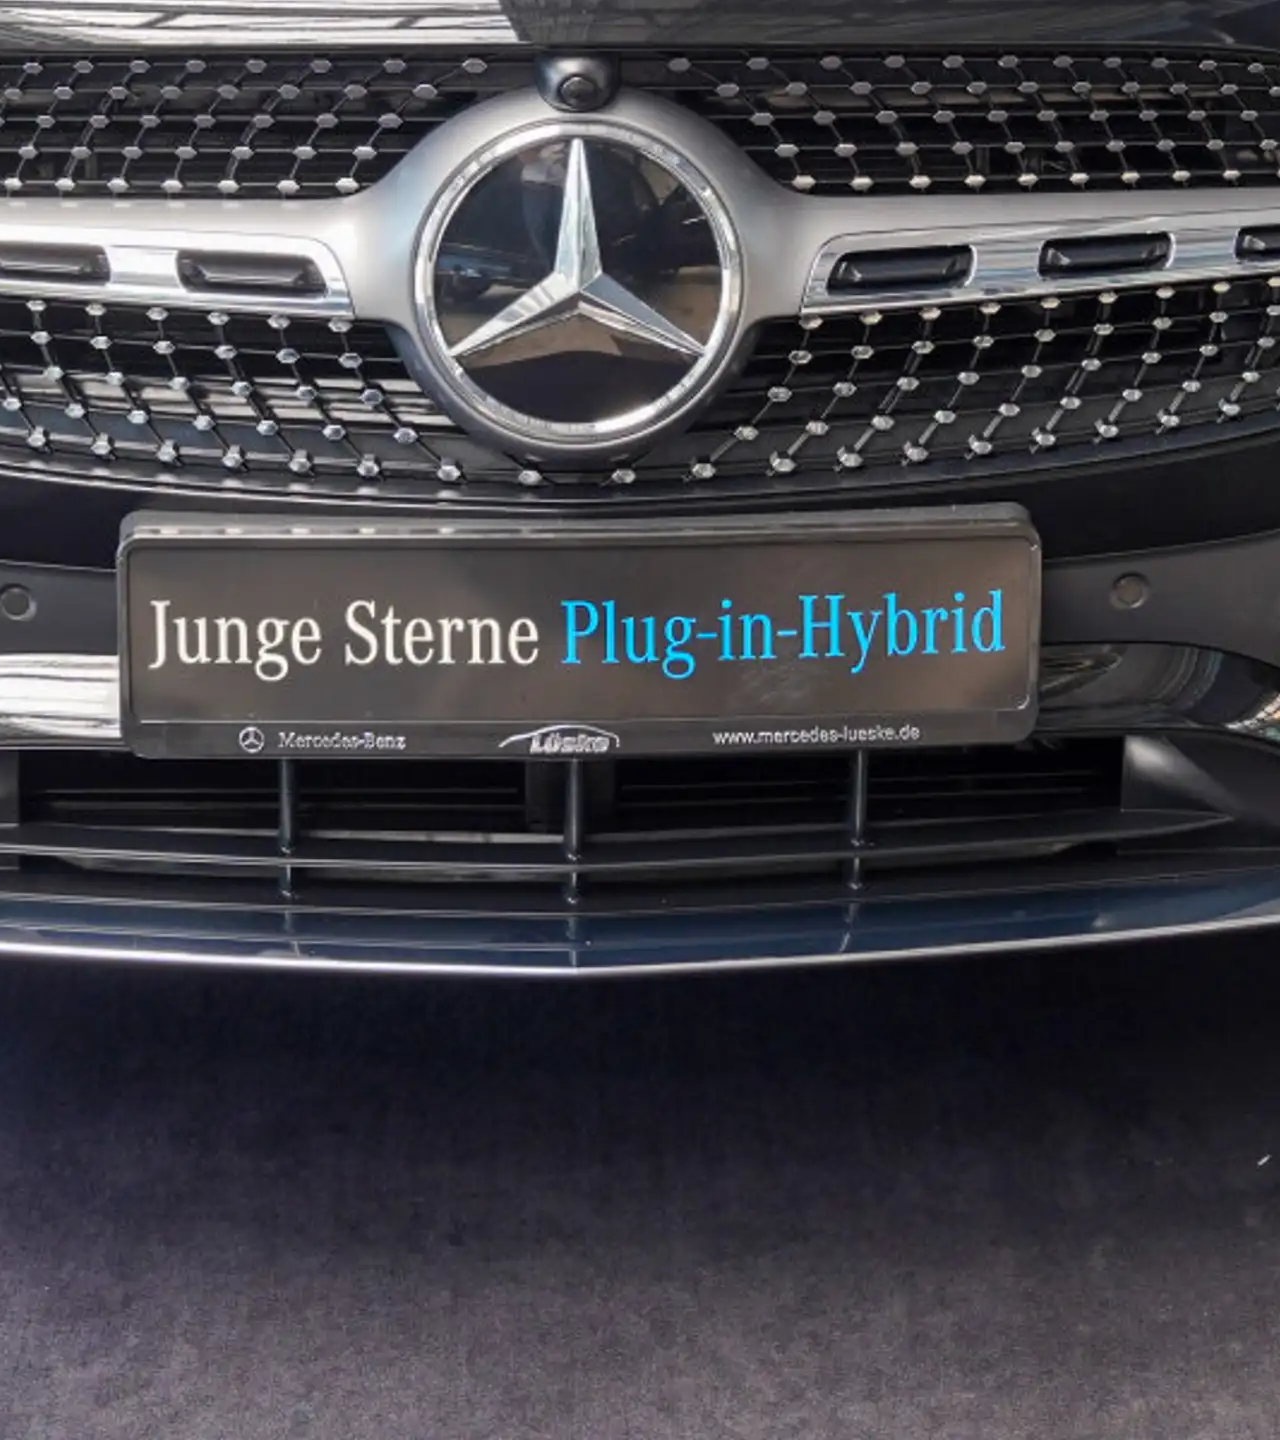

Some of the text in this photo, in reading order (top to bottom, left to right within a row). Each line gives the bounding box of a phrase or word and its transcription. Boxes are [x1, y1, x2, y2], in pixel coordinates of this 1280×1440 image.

[148, 589, 1006, 682] Junge Sterne Plug-in-Hybrid
[277, 731, 407, 750] Mercedes-Benz
[711, 724, 920, 745] www.mercedes-lueske.de
